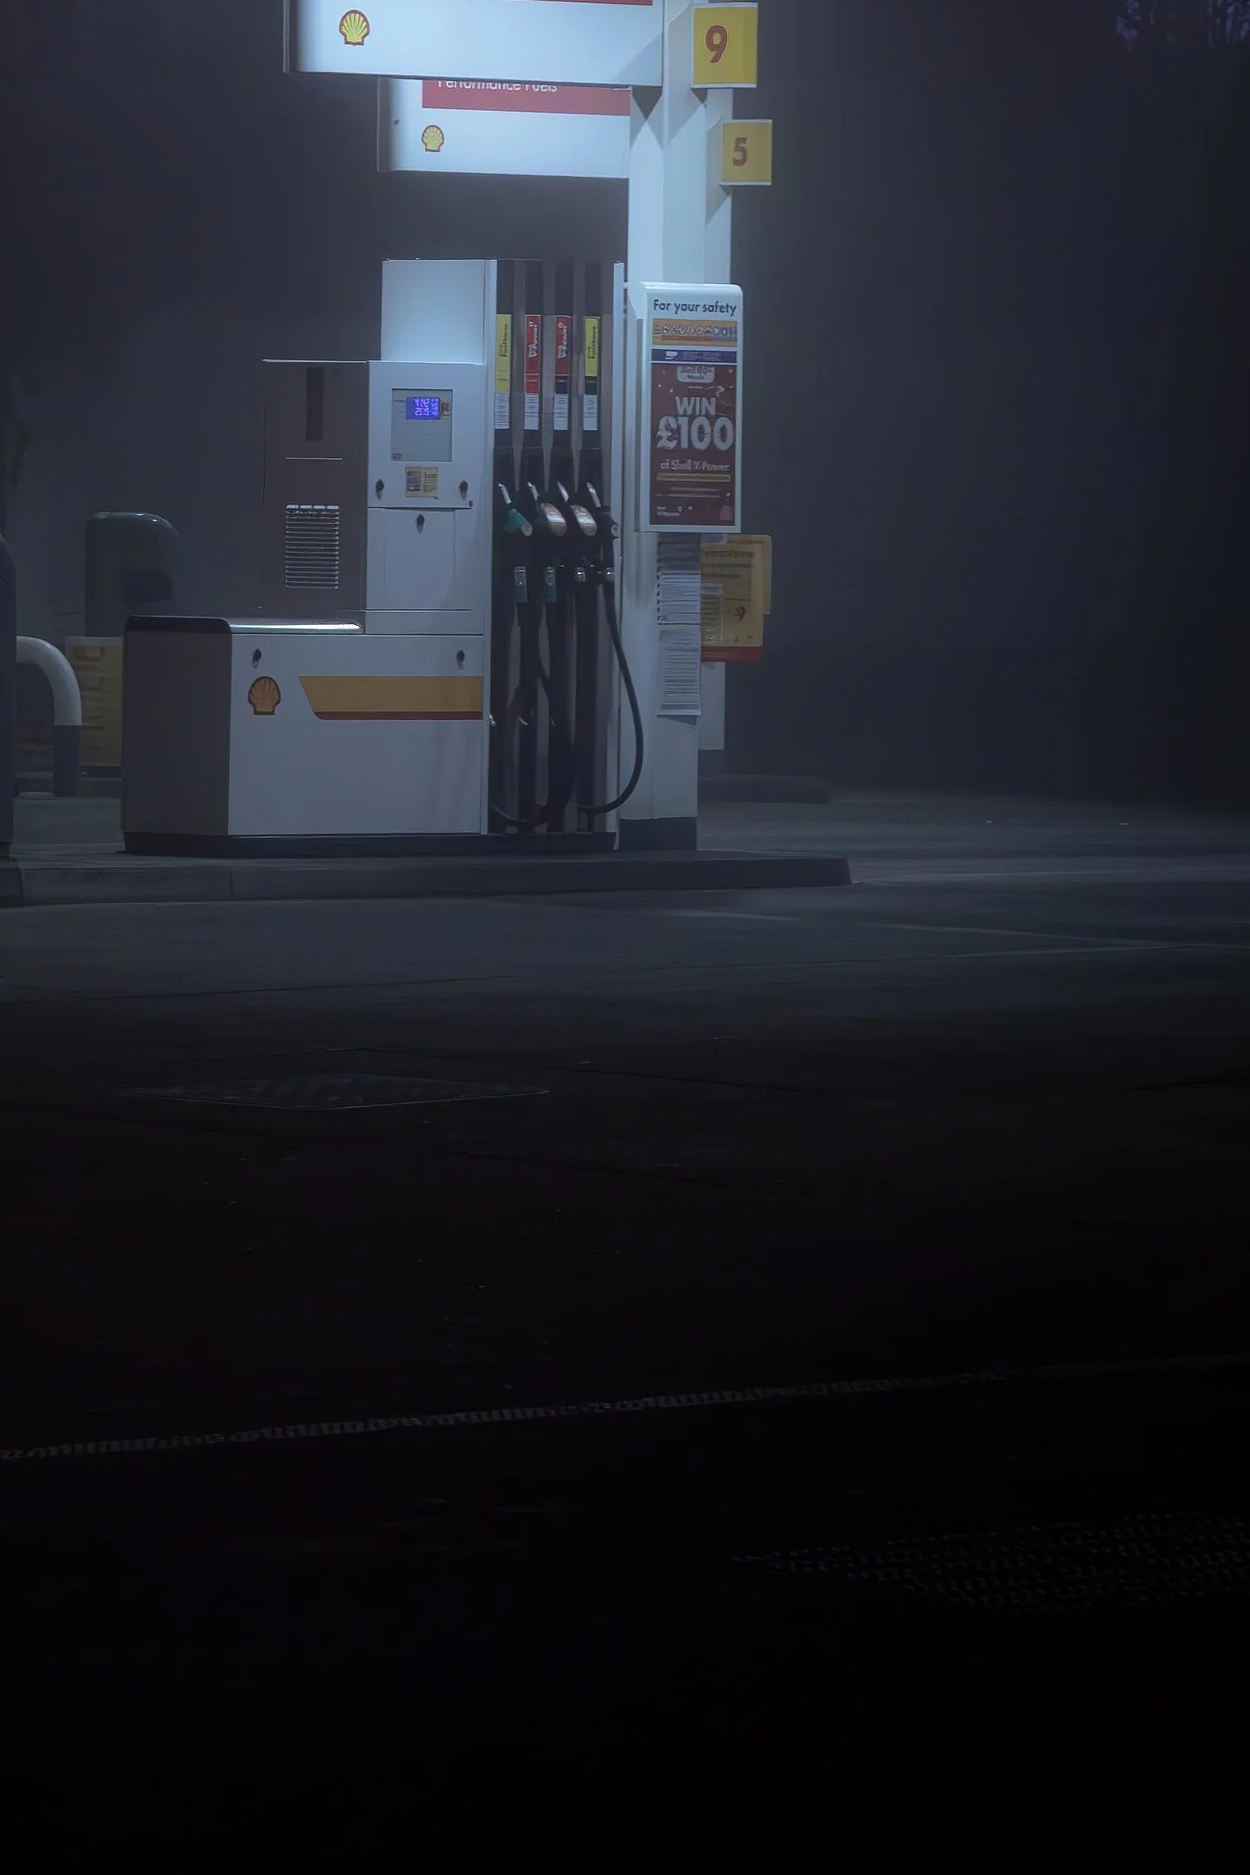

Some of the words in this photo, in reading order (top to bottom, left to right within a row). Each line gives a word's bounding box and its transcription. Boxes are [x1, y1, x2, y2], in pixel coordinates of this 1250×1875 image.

[705, 24, 728, 63] 9
[732, 136, 748, 167] 5
[653, 299, 672, 311] For
[674, 302, 700, 315] your
[702, 299, 737, 316] safety
[675, 396, 716, 416] WIN
[656, 416, 735, 451] £100
